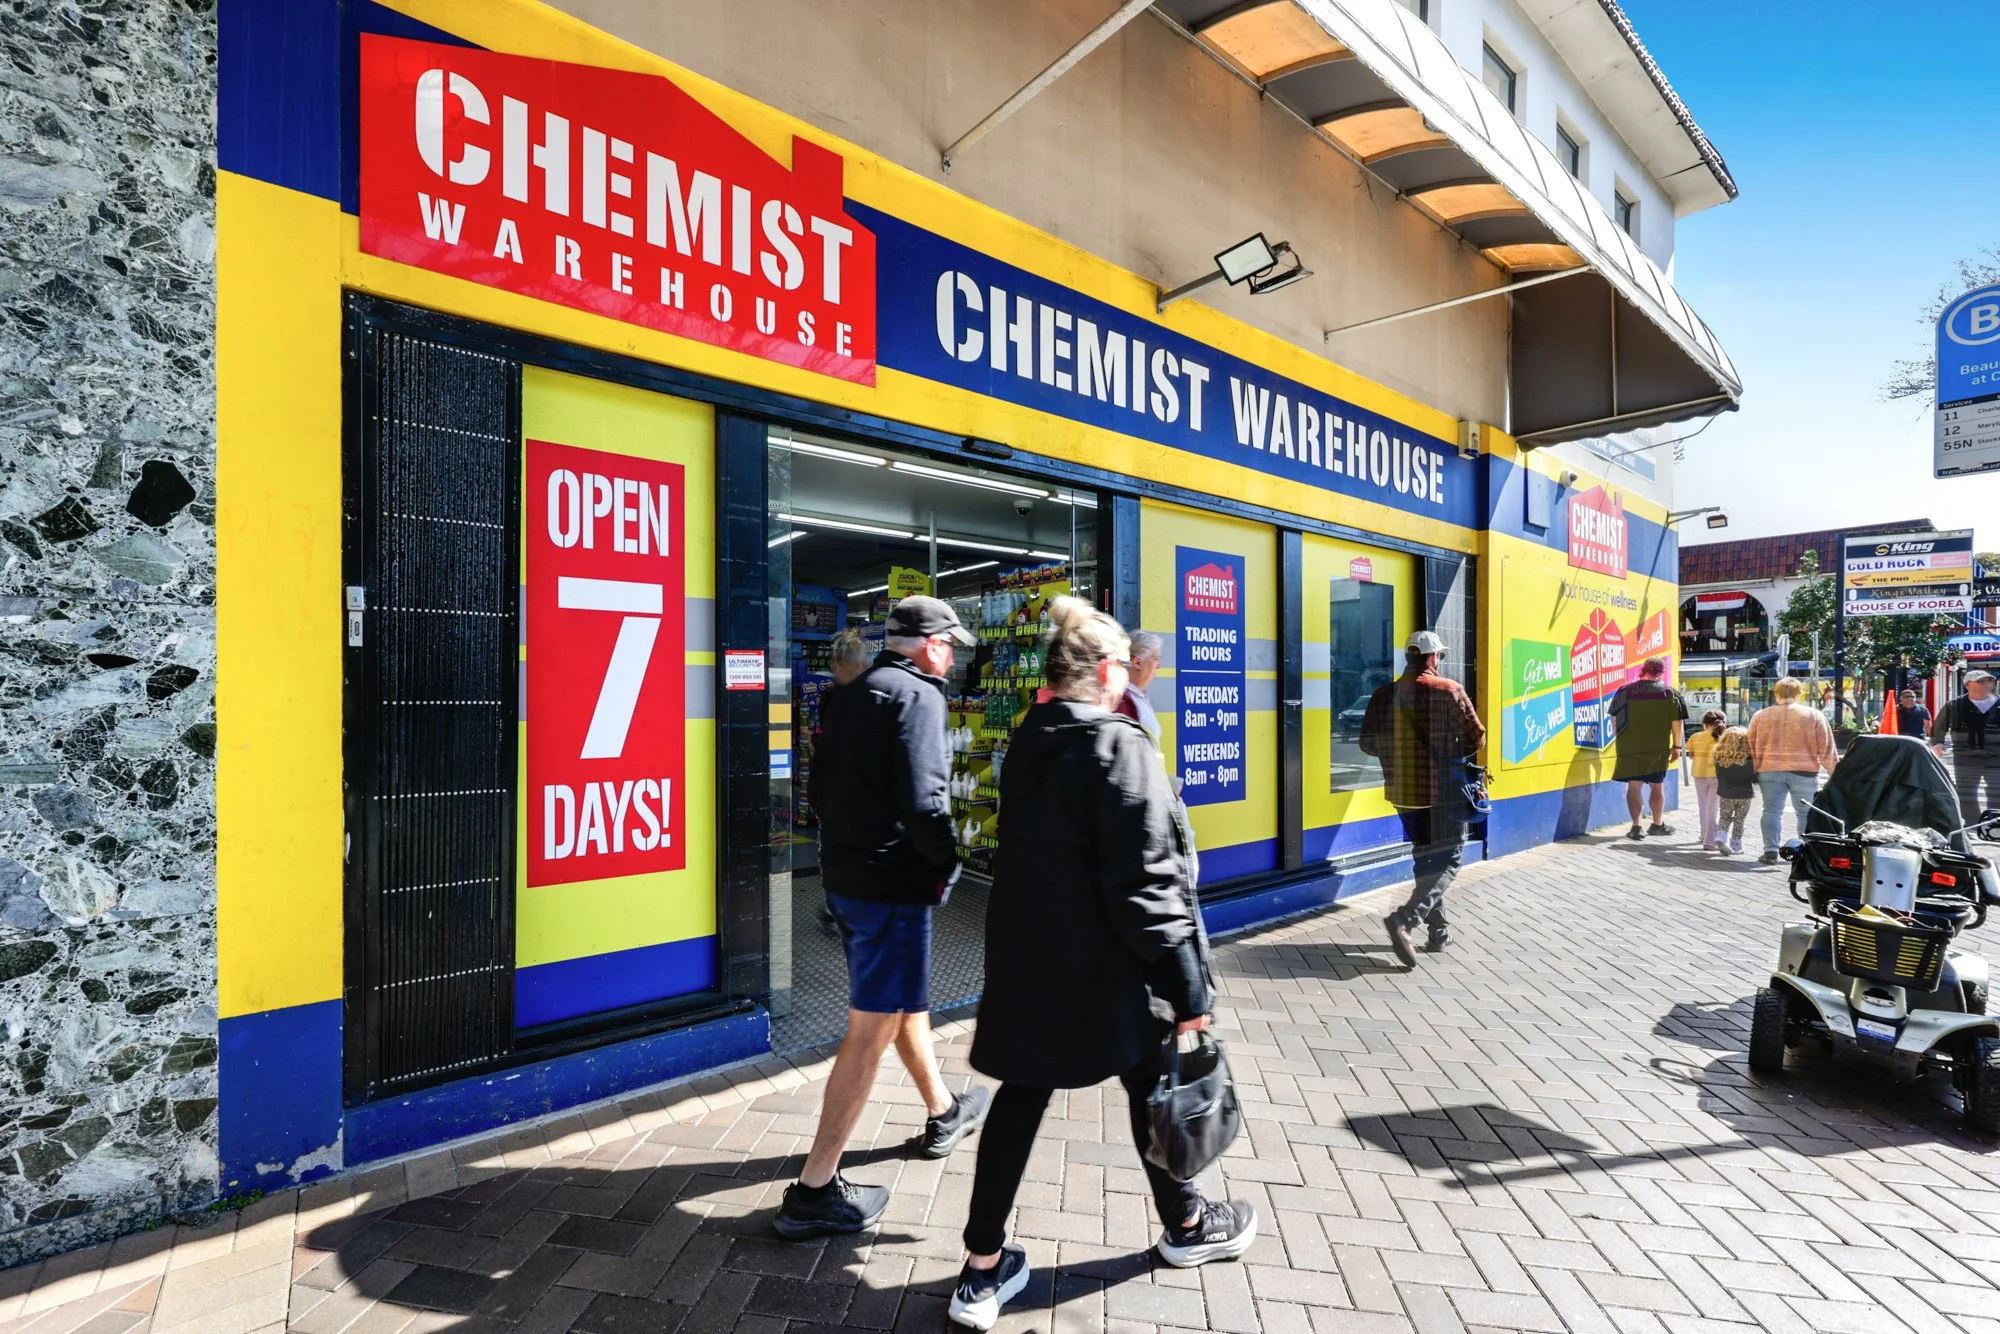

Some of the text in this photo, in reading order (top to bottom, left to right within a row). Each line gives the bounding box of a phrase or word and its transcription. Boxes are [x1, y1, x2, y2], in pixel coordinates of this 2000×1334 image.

[415, 68, 852, 305] CHEMIST
[417, 192, 852, 357] WAREHOUSE
[936, 270, 1443, 505] CHEMIST WAREHOUSE
[1971, 374, 1987, 385] at
[1943, 399, 1973, 408] Services
[1944, 411, 1959, 421] 11
[1944, 426, 1960, 436] 12
[1944, 439, 1973, 451] 55N
[547, 468, 669, 557] OPEN
[1573, 502, 1623, 551] CHEMIST
[1573, 542, 1624, 570] WAREHOUSE
[1891, 542, 1935, 552] King
[1188, 575, 1234, 599] CHEMIST
[1578, 581, 1601, 604] house
[1602, 588, 1610, 606] of
[1610, 590, 1637, 611] wellness
[1870, 587, 1904, 598] Kings
[1909, 585, 1946, 596] Valley
[1188, 597, 1234, 610] WAREHOUSE
[1851, 602, 1894, 611] HOUSE
[1897, 602, 1915, 610] OF
[1918, 599, 1965, 609] KOREA
[1185, 626, 1237, 644] TRADING
[1651, 612, 1663, 649] well
[1192, 645, 1231, 662] HOURS
[1572, 645, 1597, 679] CHEMIST
[1601, 643, 1624, 669] CHEMIST
[557, 576, 663, 759] 7
[1521, 646, 1562, 710] Get well
[1184, 686, 1238, 704] WEEKDAYS
[1572, 675, 1598, 694] WAREHOUSE
[1185, 709, 1206, 727] 8am
[1217, 709, 1238, 731] 9pm
[1574, 704, 1599, 723] DISCOUNT
[1523, 690, 1565, 760] Stay well
[1577, 725, 1598, 743] CHEMIST
[1184, 742, 1239, 762] WEEKENDS
[1185, 767, 1207, 786] 8am
[1217, 765, 1238, 787] 8pm
[544, 778, 671, 860] DAYS!
[1204, 1231, 1228, 1242] HOKA
